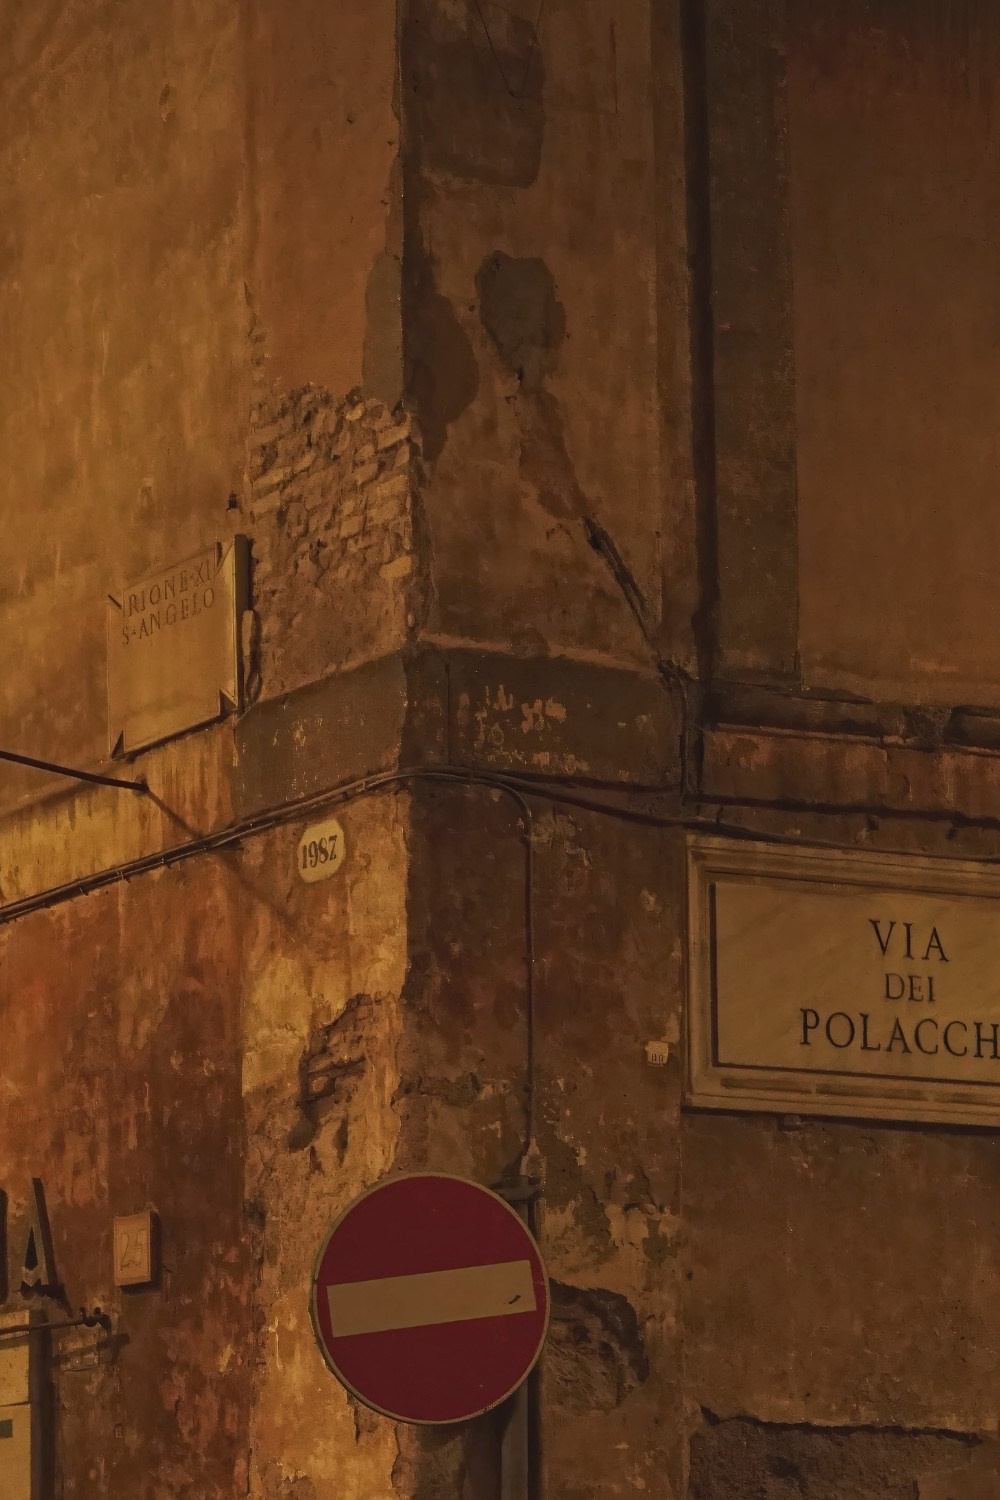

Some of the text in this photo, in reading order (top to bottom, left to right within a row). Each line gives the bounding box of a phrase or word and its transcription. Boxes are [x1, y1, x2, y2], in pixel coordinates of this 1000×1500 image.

[868, 918, 950, 962] VIA
[884, 972, 937, 1002] DEI
[799, 1007, 1000, 1060] POLACCH
